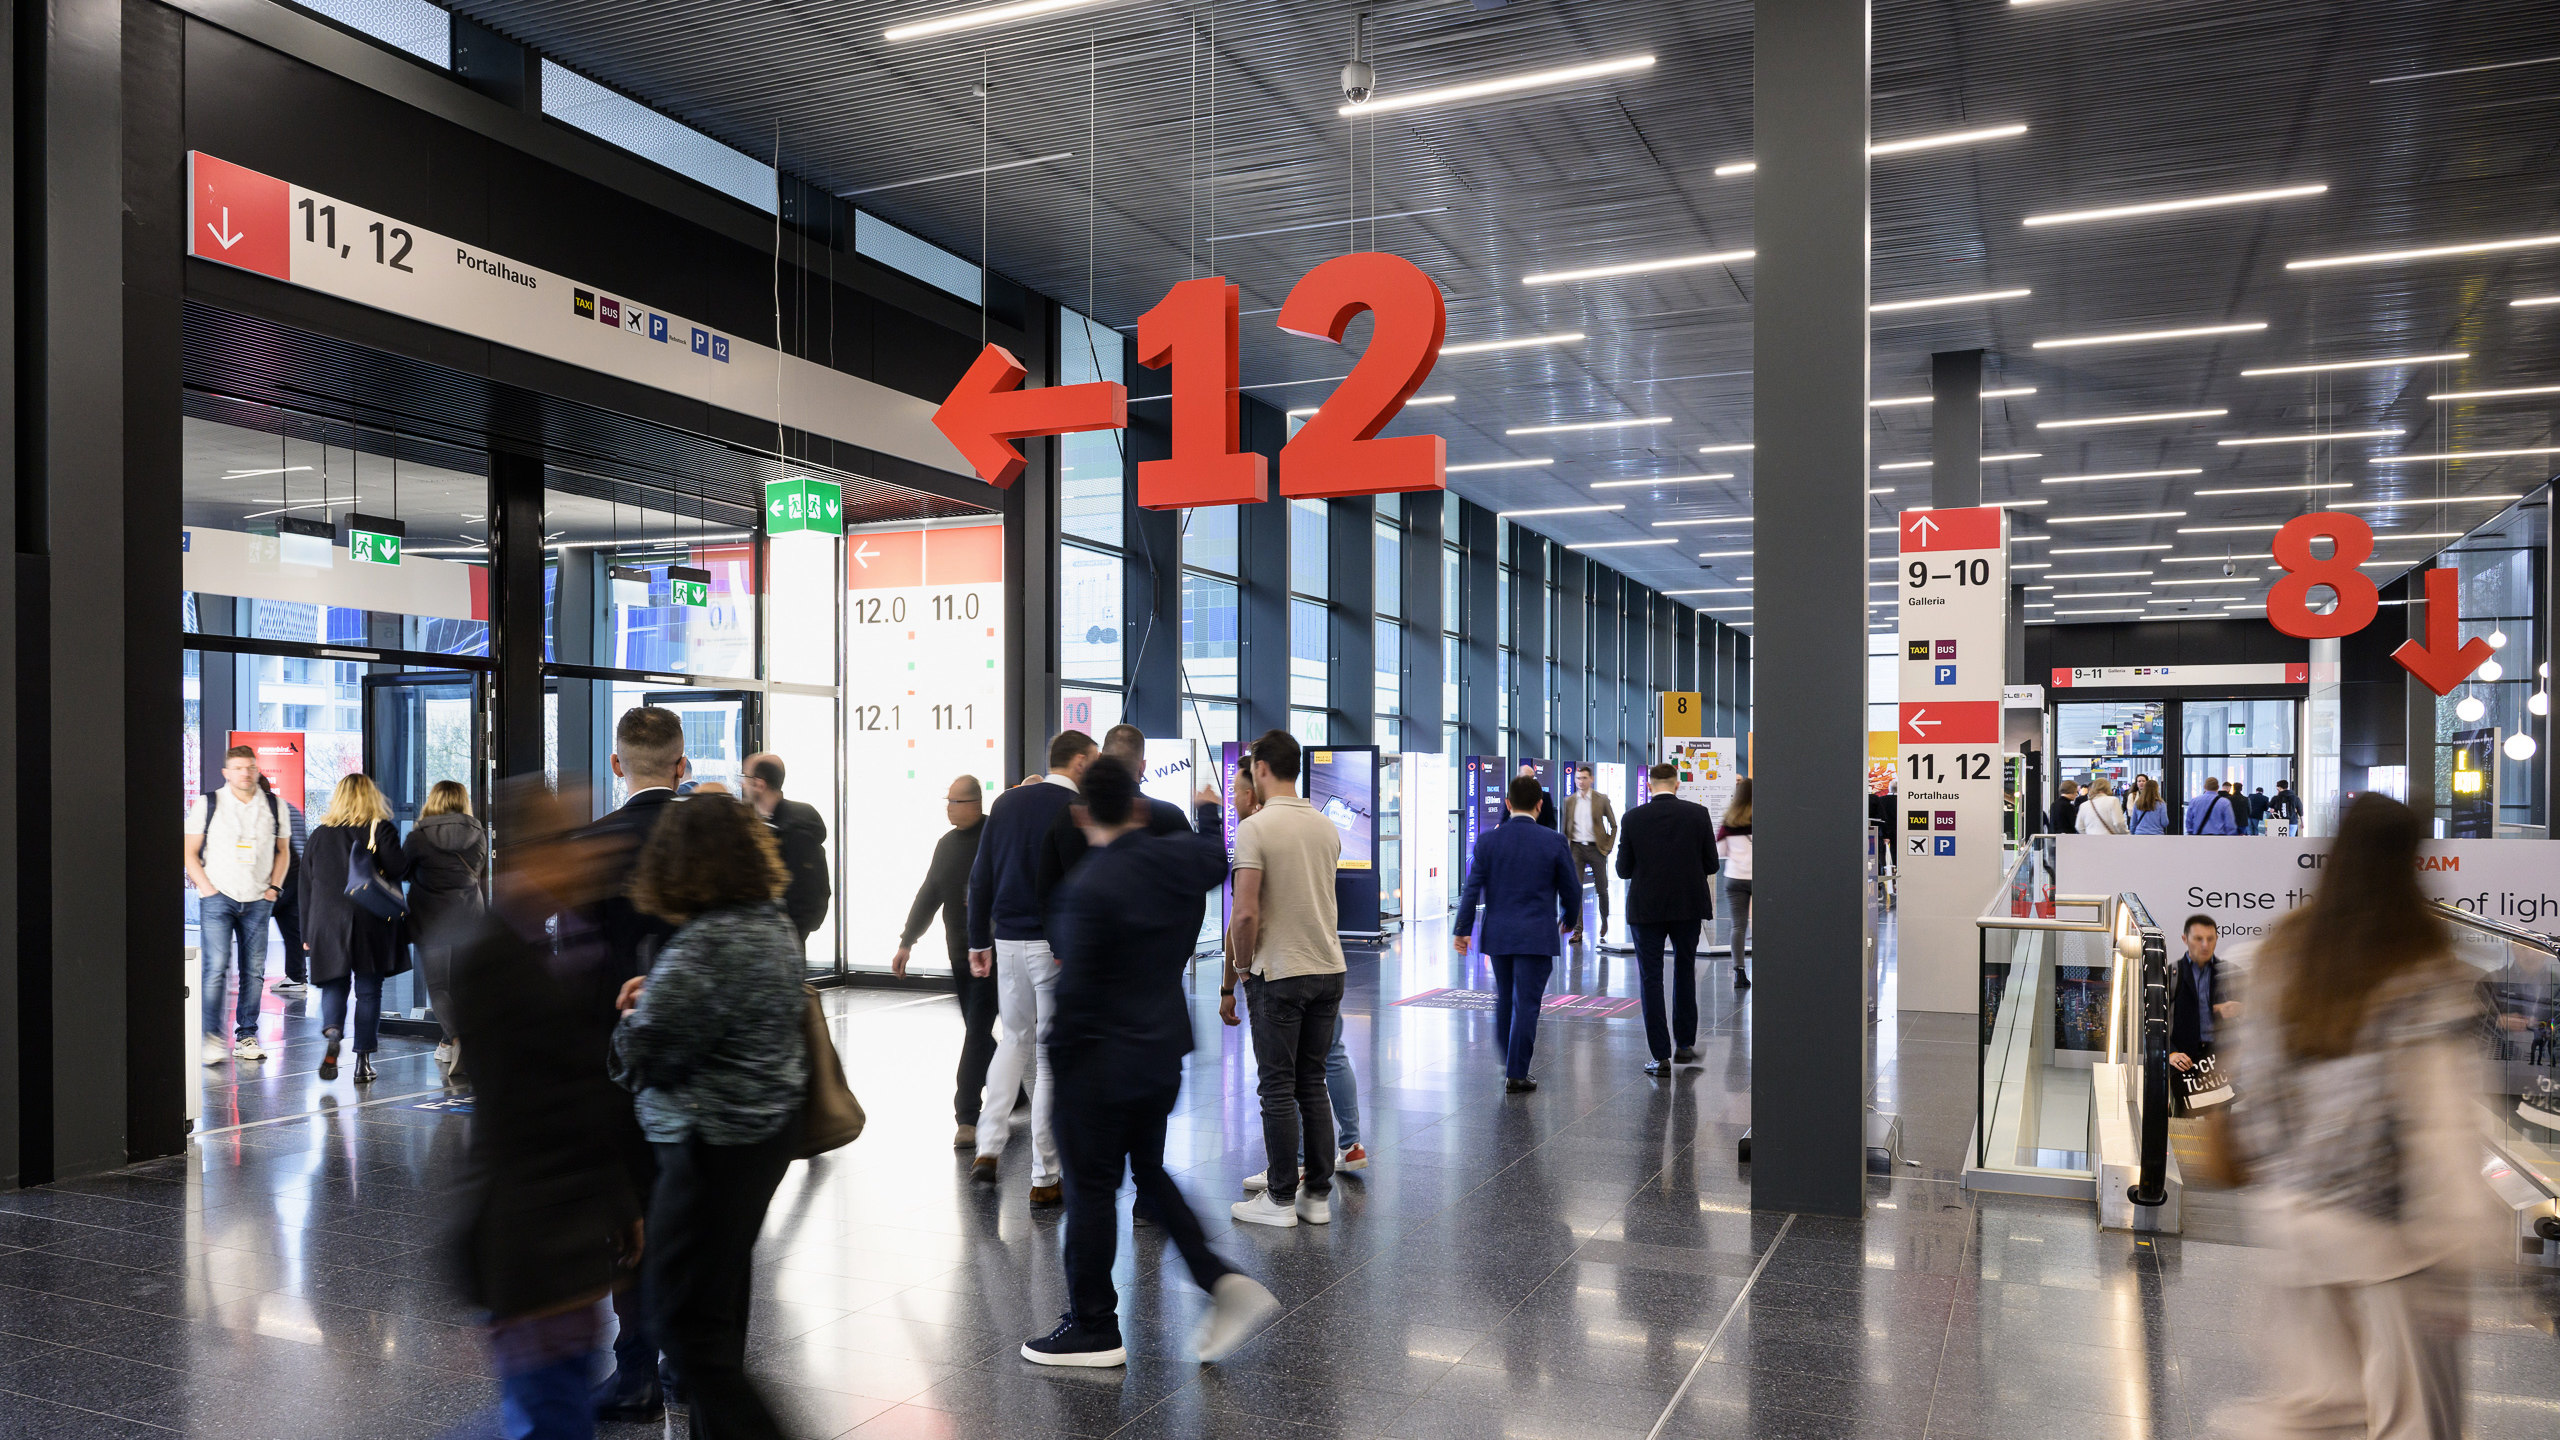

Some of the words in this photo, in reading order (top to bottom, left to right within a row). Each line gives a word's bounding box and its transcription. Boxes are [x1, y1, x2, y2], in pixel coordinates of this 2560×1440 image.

[298, 197, 351, 260] 11,
[369, 221, 414, 274] 12
[456, 247, 537, 290] Portalhaus
[575, 296, 593, 311] TAXI
[601, 305, 618, 319] BUS
[653, 319, 663, 336] P
[695, 333, 705, 350] P
[715, 342, 726, 357] 12
[1138, 251, 1447, 510] 12
[2266, 511, 2379, 640] 8
[932, 592, 980, 621] 11.0
[1908, 596, 1946, 606] Galleria
[855, 596, 906, 624] 12.0
[1910, 646, 1928, 654] TAXI
[1937, 646, 1955, 654] BUS
[1940, 668, 1951, 682] P
[1065, 702, 1089, 724] 10
[1678, 697, 1687, 714] 8
[855, 704, 899, 731] 12.1
[931, 703, 973, 730] 11.1
[1227, 763, 1235, 780] Hall
[1907, 753, 1945, 784] 11,
[1955, 752, 1991, 780] 12
[1907, 791, 1960, 800] Portalhaus
[1909, 816, 1927, 824] TAXI
[1936, 817, 1954, 825] BUS
[1226, 825, 1235, 844] A35,
[1939, 839, 1950, 853] P
[1227, 848, 1235, 863] B15
[2413, 855, 2460, 872] RAM
[2187, 886, 2276, 910] Sense
[2285, 887, 2314, 909] th
[2455, 892, 2490, 915] of
[2501, 892, 2559, 923] ligh
[2215, 922, 2263, 938] xplore
